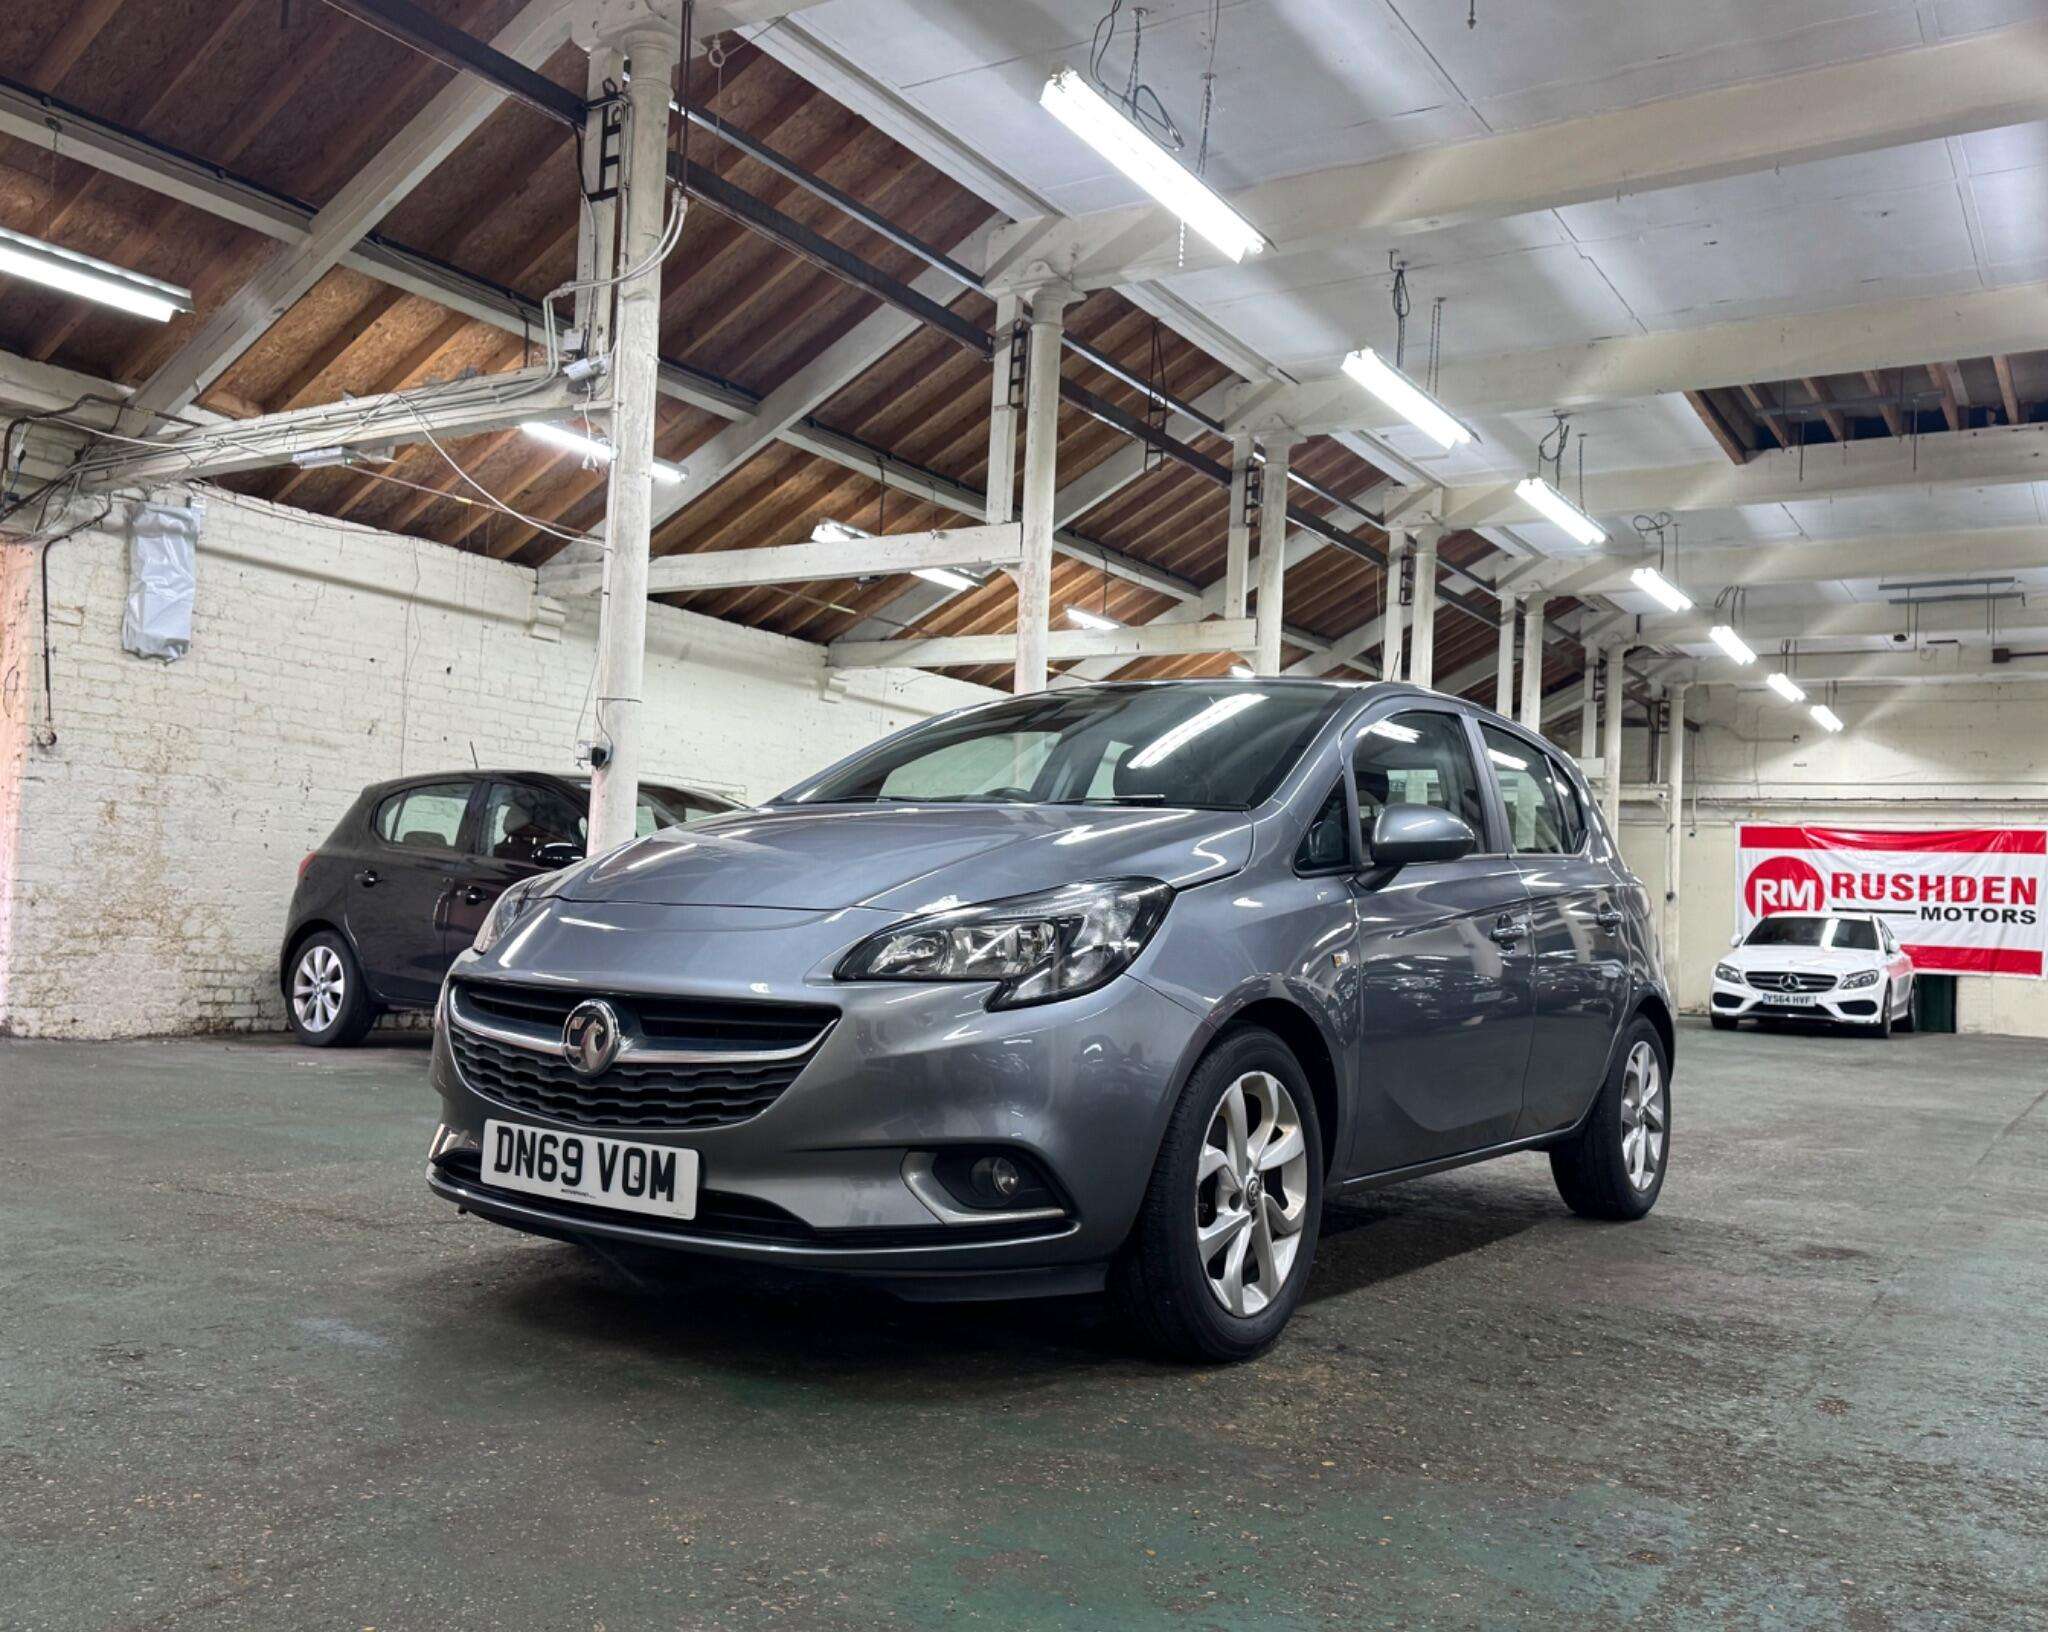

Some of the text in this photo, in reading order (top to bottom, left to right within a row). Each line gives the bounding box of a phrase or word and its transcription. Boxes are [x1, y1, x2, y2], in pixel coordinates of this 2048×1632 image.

[1755, 878, 1816, 915] RM
[1831, 872, 2037, 905] RUSHDEN
[1921, 906, 2037, 924] MOTORS
[494, 1126, 676, 1202] DN69 VOM
